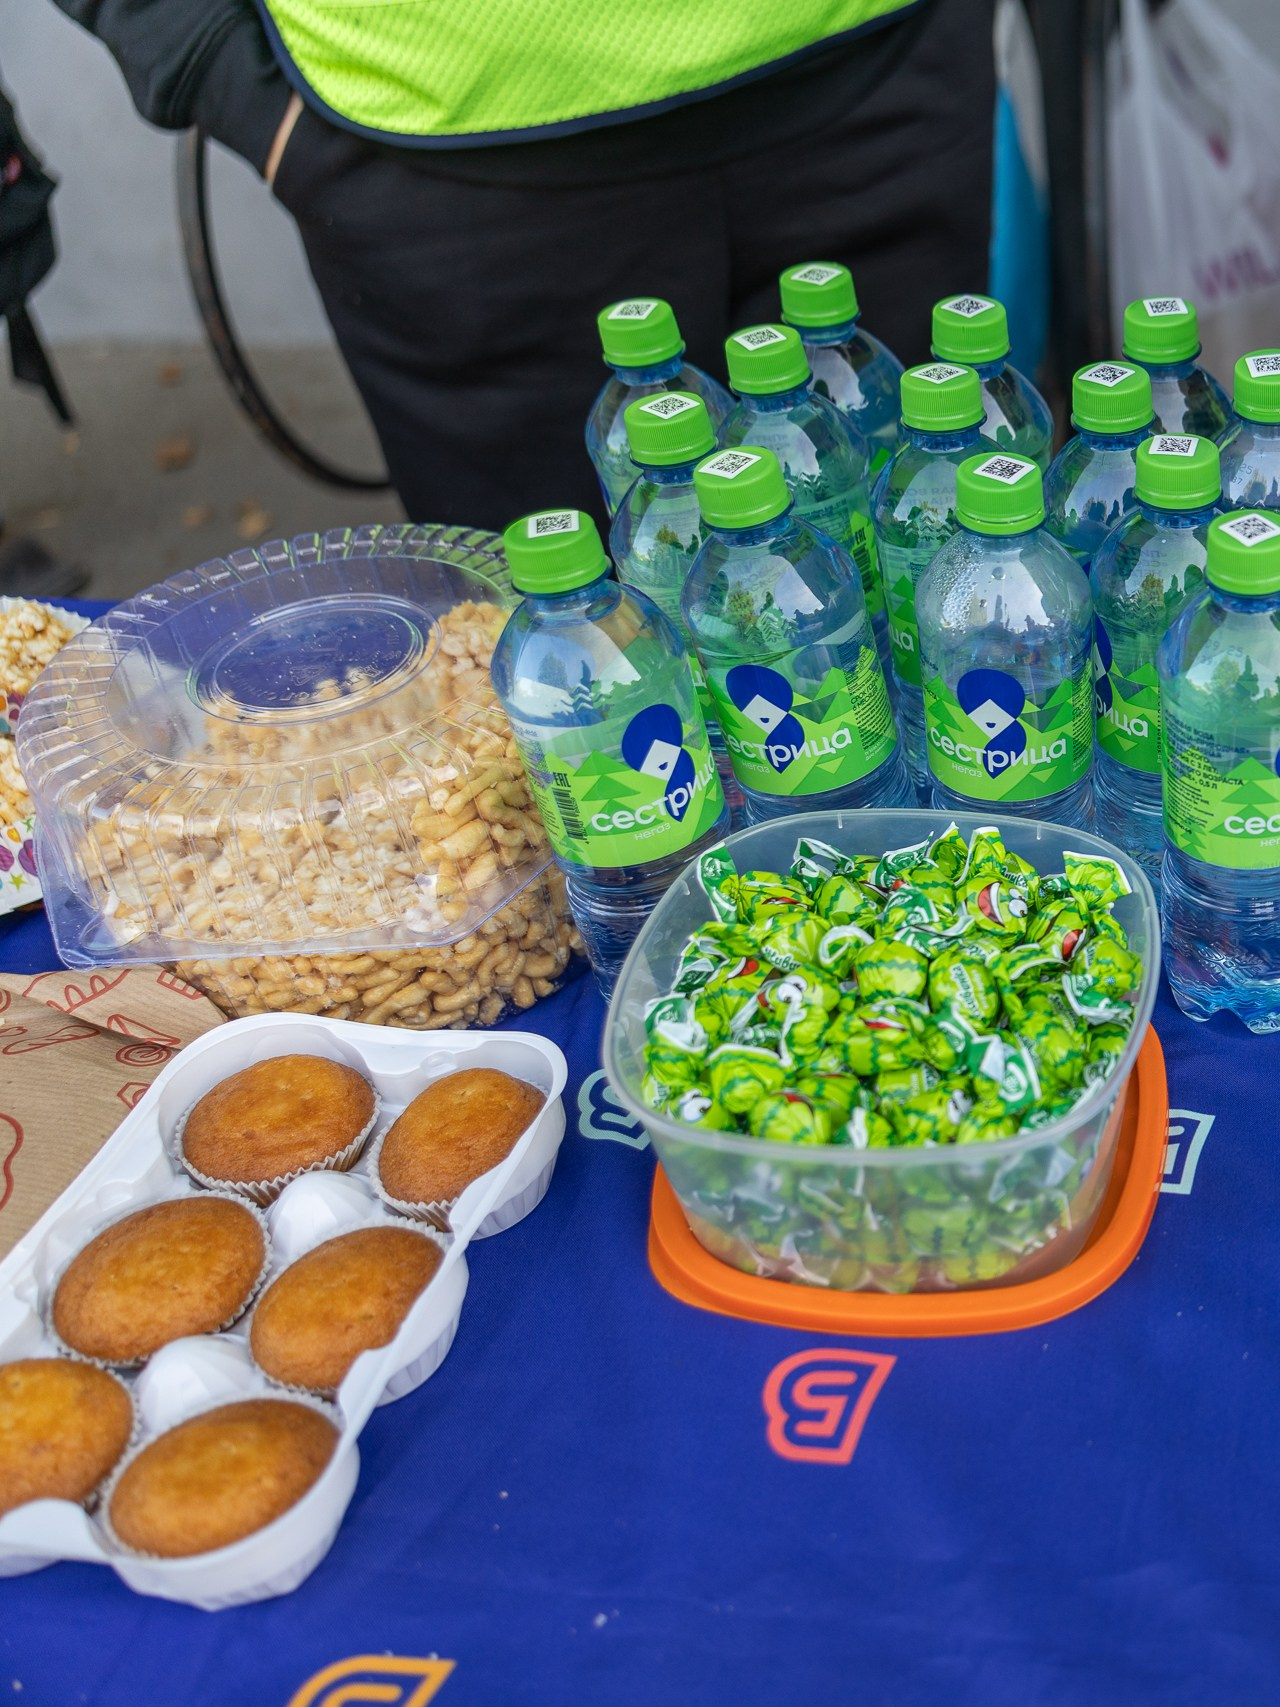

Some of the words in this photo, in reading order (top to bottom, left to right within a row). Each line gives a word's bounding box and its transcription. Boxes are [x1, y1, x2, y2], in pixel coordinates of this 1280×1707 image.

[930, 727, 1067, 773] сестрица
[951, 763, 983, 778] негаз
[634, 823, 671, 840] негаз
